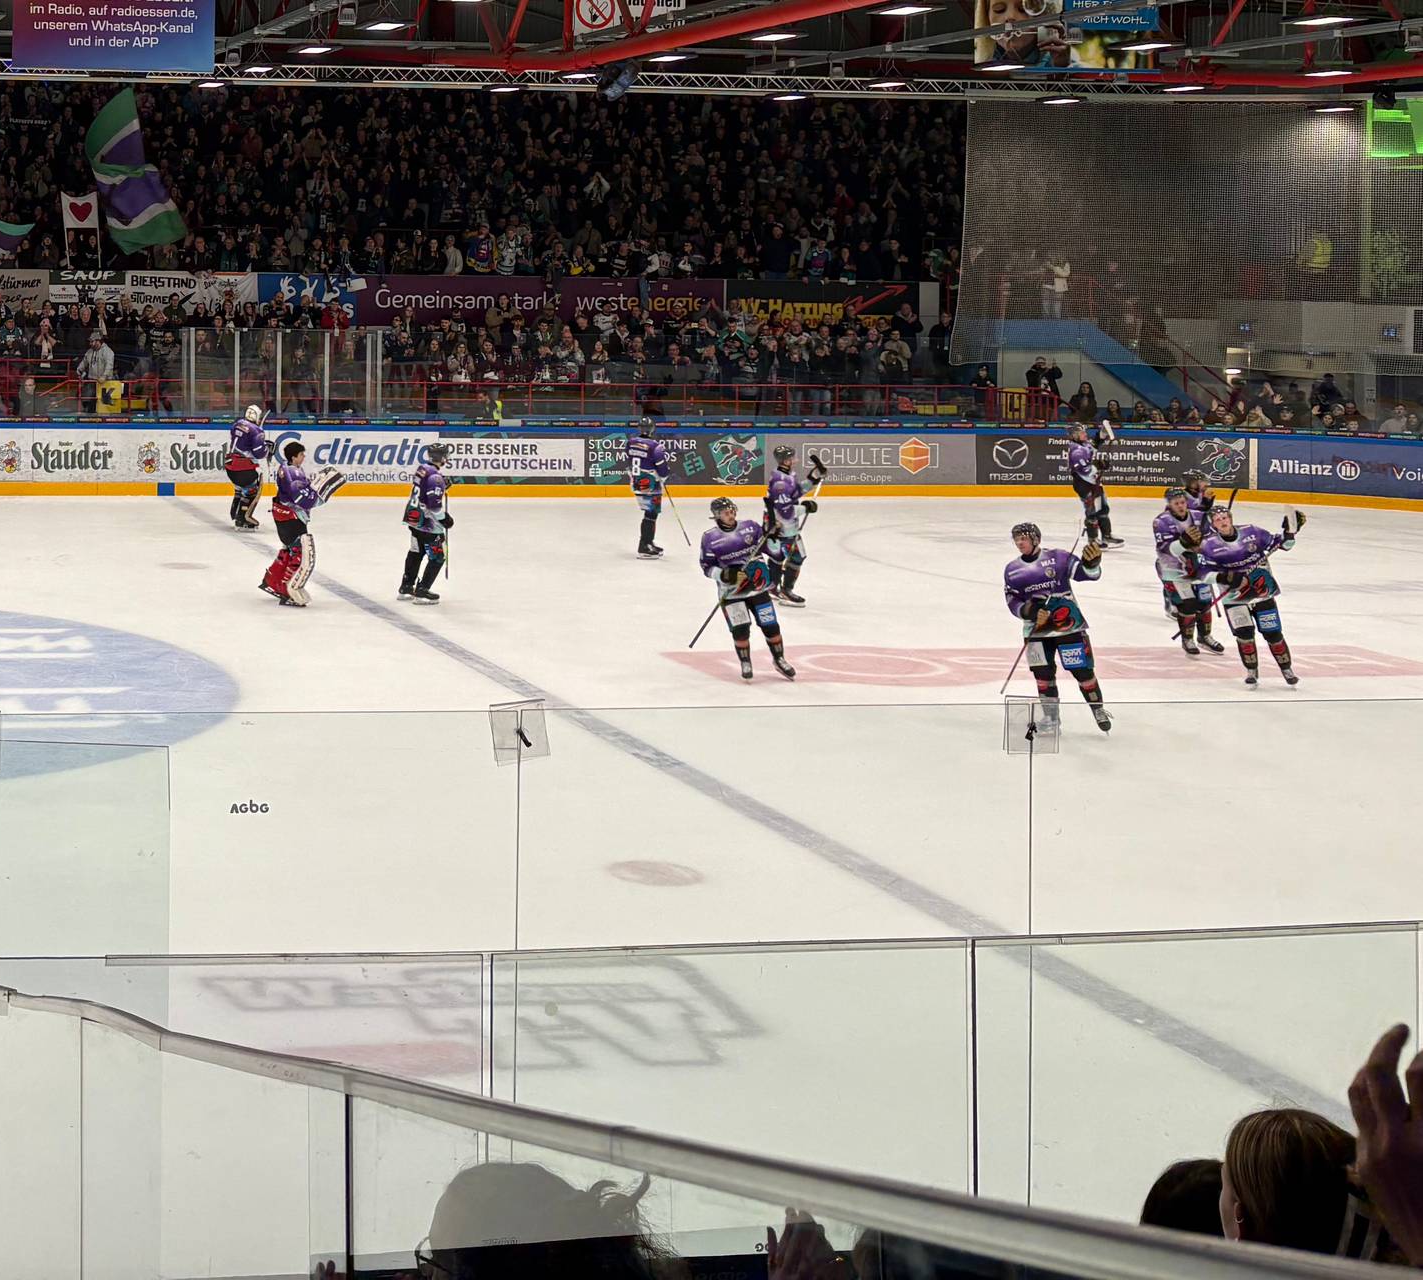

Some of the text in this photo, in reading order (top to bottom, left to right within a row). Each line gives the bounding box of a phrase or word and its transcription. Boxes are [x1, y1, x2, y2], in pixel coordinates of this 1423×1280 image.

[30, 4, 198, 19] im Radio, auf radioessen.de,
[34, 20, 194, 34] unserem WhatsApp-Kanal
[68, 36, 159, 48] und in der APP
[131, 274, 197, 290] BIERSTAND
[375, 288, 495, 311] Gemeinsam
[100, 386, 115, 405] K
[445, 443, 538, 456] DER ESSENER
[588, 439, 697, 450] STOLZ RTNER
[1120, 439, 1164, 448] Traumwagen
[31, 441, 114, 473] Stauder
[169, 441, 228, 473] Staud
[588, 452, 613, 462] DER
[807, 447, 892, 465] SCHULTE
[631, 457, 641, 476] 8
[1137, 466, 1165, 474] Partner
[1269, 459, 1333, 476] Allianz
[1392, 466, 1423, 481] Voi
[825, 472, 892, 483] obilien-Gruppe
[989, 473, 1033, 481] mazda
[1139, 475, 1176, 483] Hattingen
